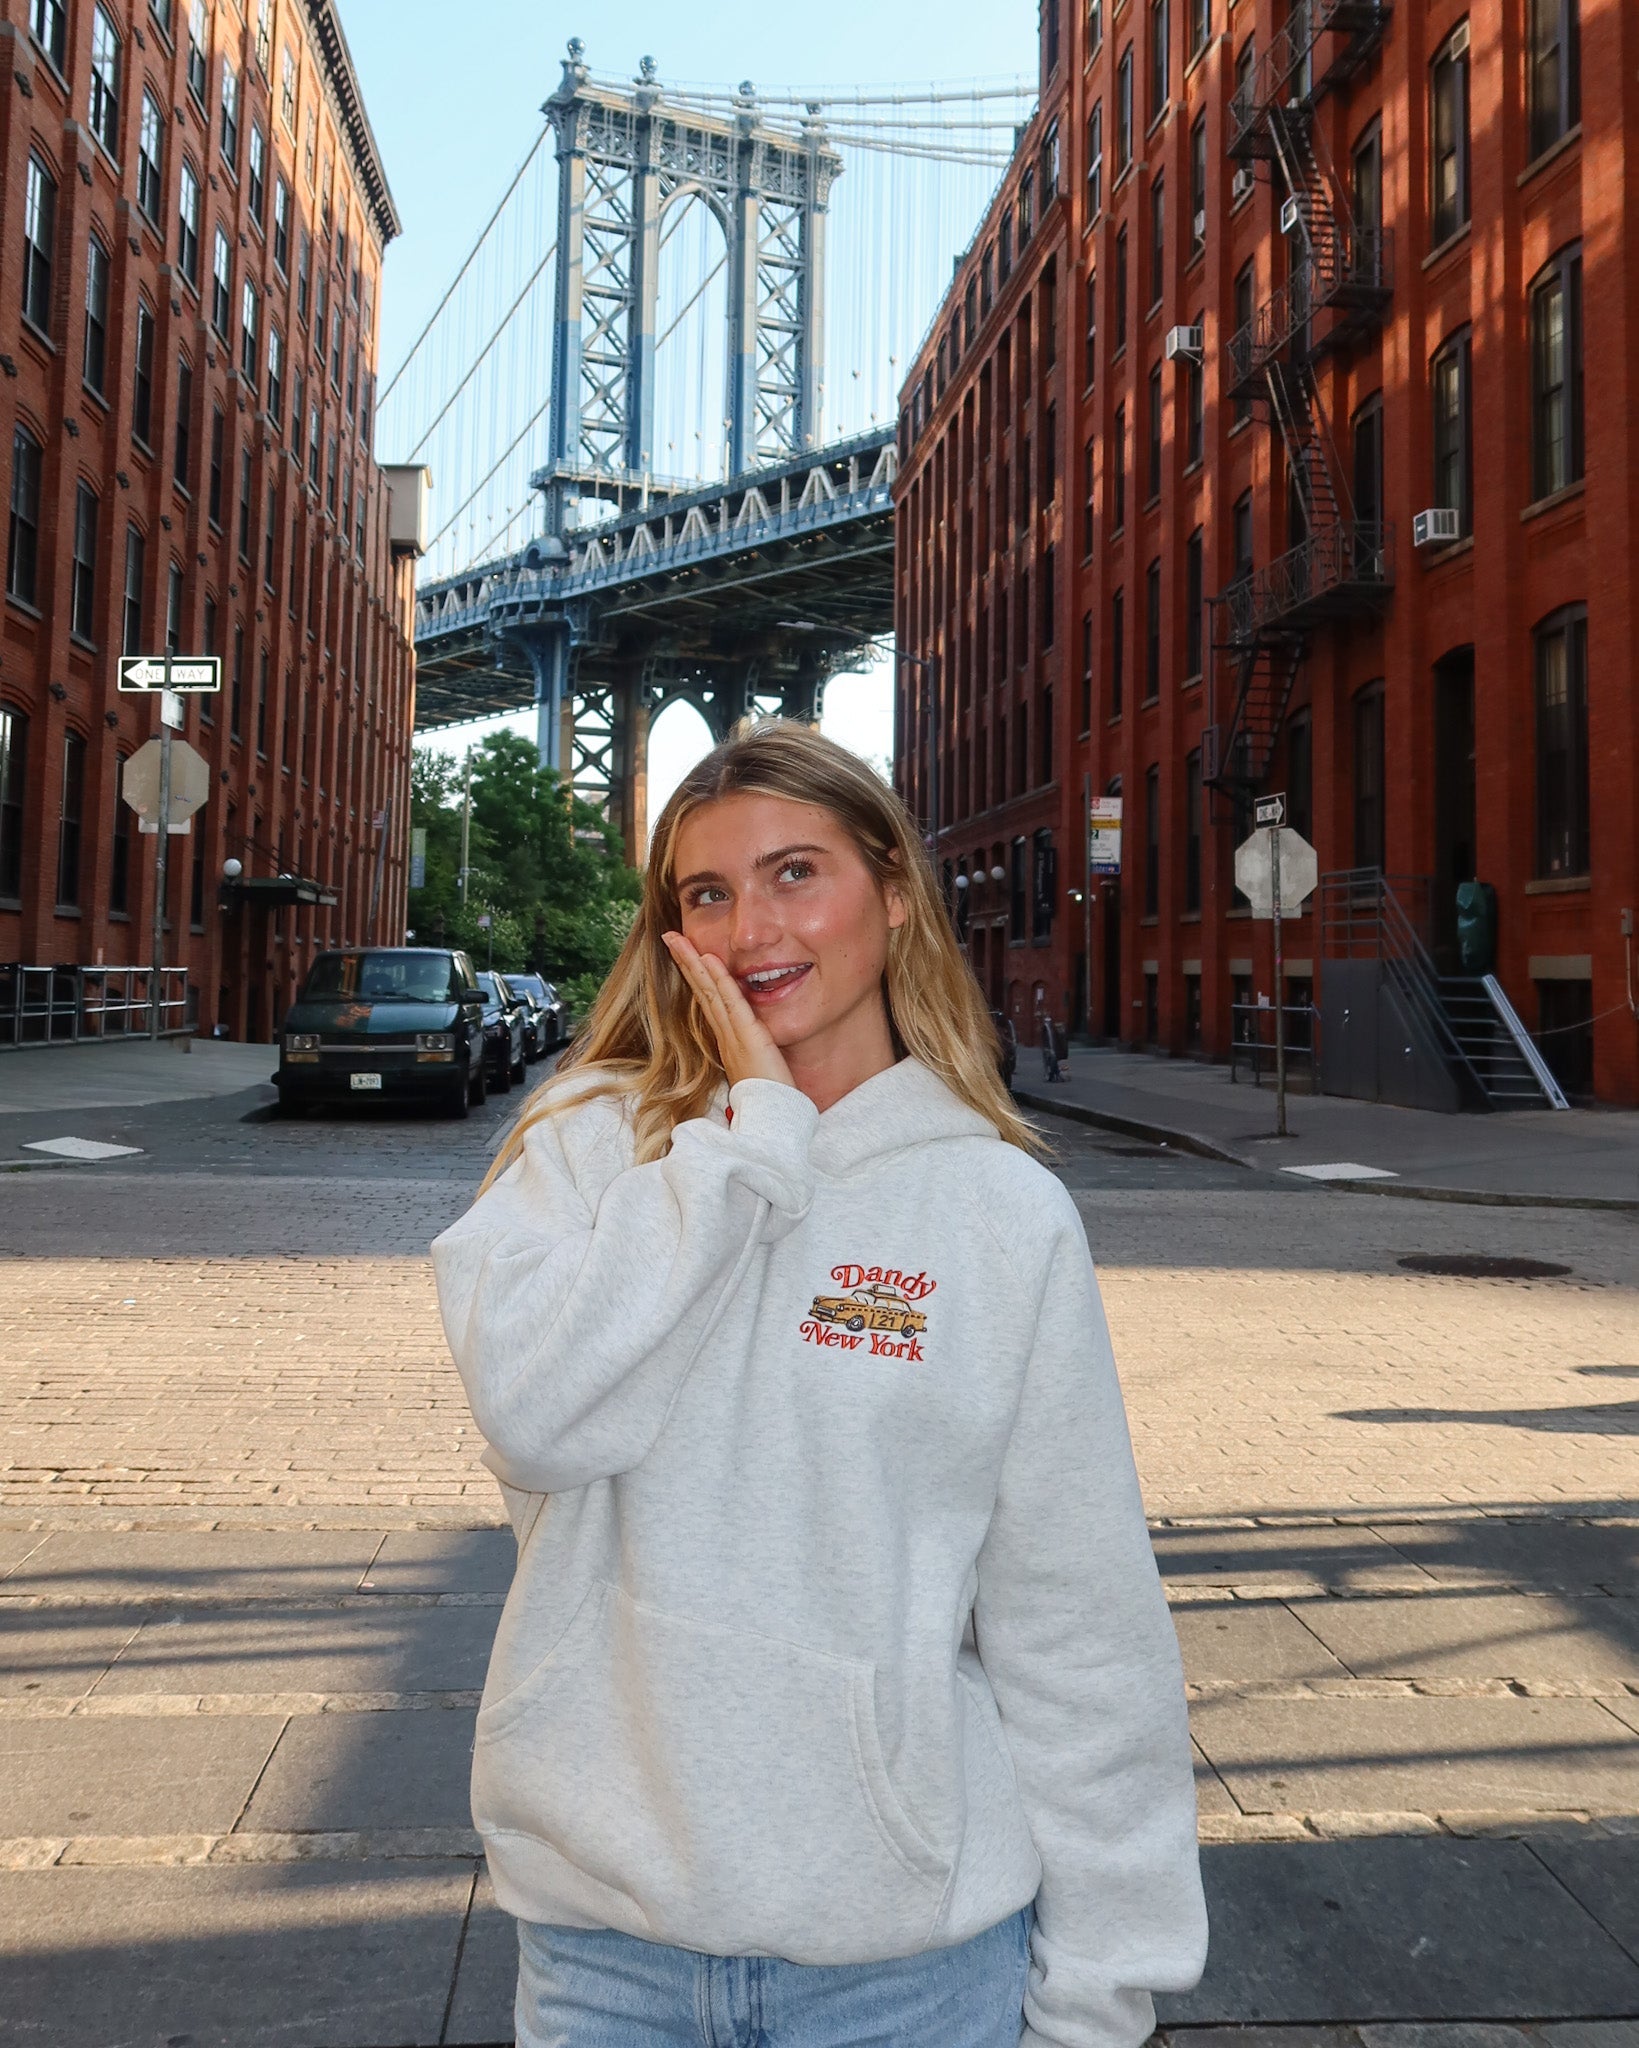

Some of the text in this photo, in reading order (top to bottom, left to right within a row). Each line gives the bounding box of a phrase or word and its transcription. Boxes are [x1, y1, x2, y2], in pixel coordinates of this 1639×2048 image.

[135, 668, 205, 680] ONE WAY
[830, 1264, 937, 1301] Dandy
[879, 1315, 895, 1328] 21
[800, 1321, 925, 1362] New York
